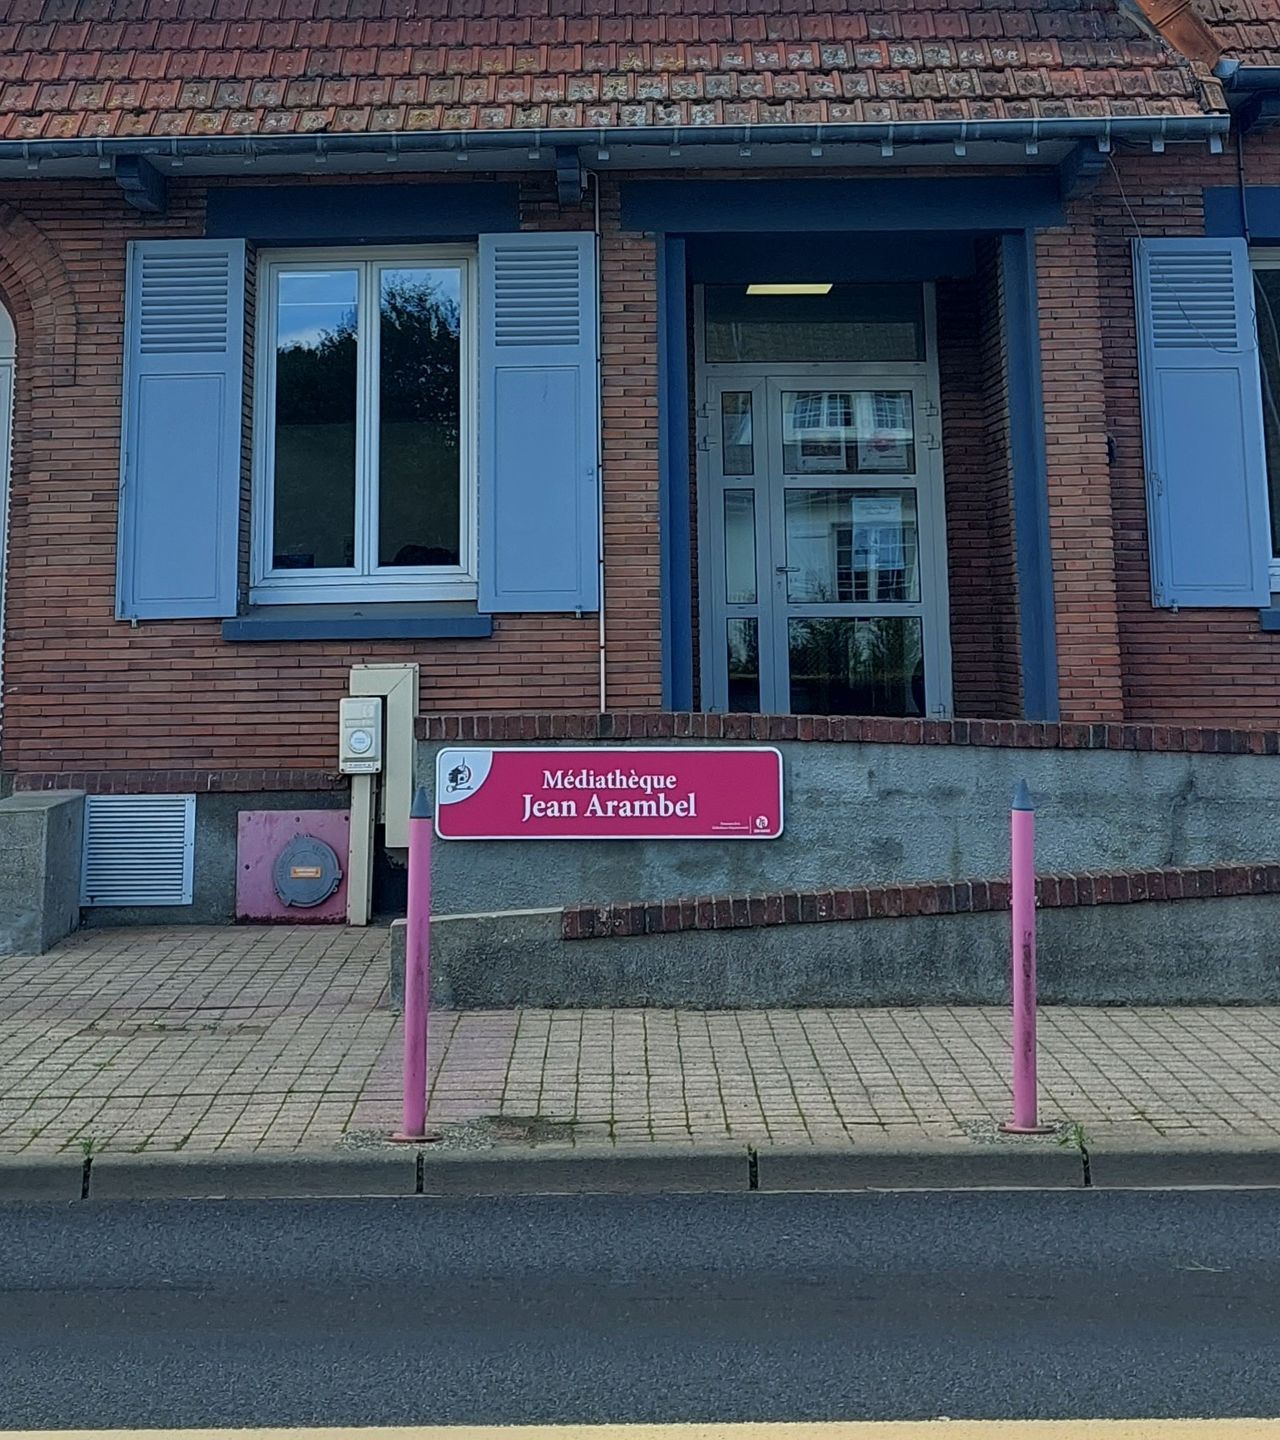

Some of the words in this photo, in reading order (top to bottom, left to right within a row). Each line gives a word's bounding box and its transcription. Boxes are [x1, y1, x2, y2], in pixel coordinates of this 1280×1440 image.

[542, 769, 677, 795] Médiathèque
[522, 793, 578, 822] Jean
[583, 792, 697, 817] Arambel
